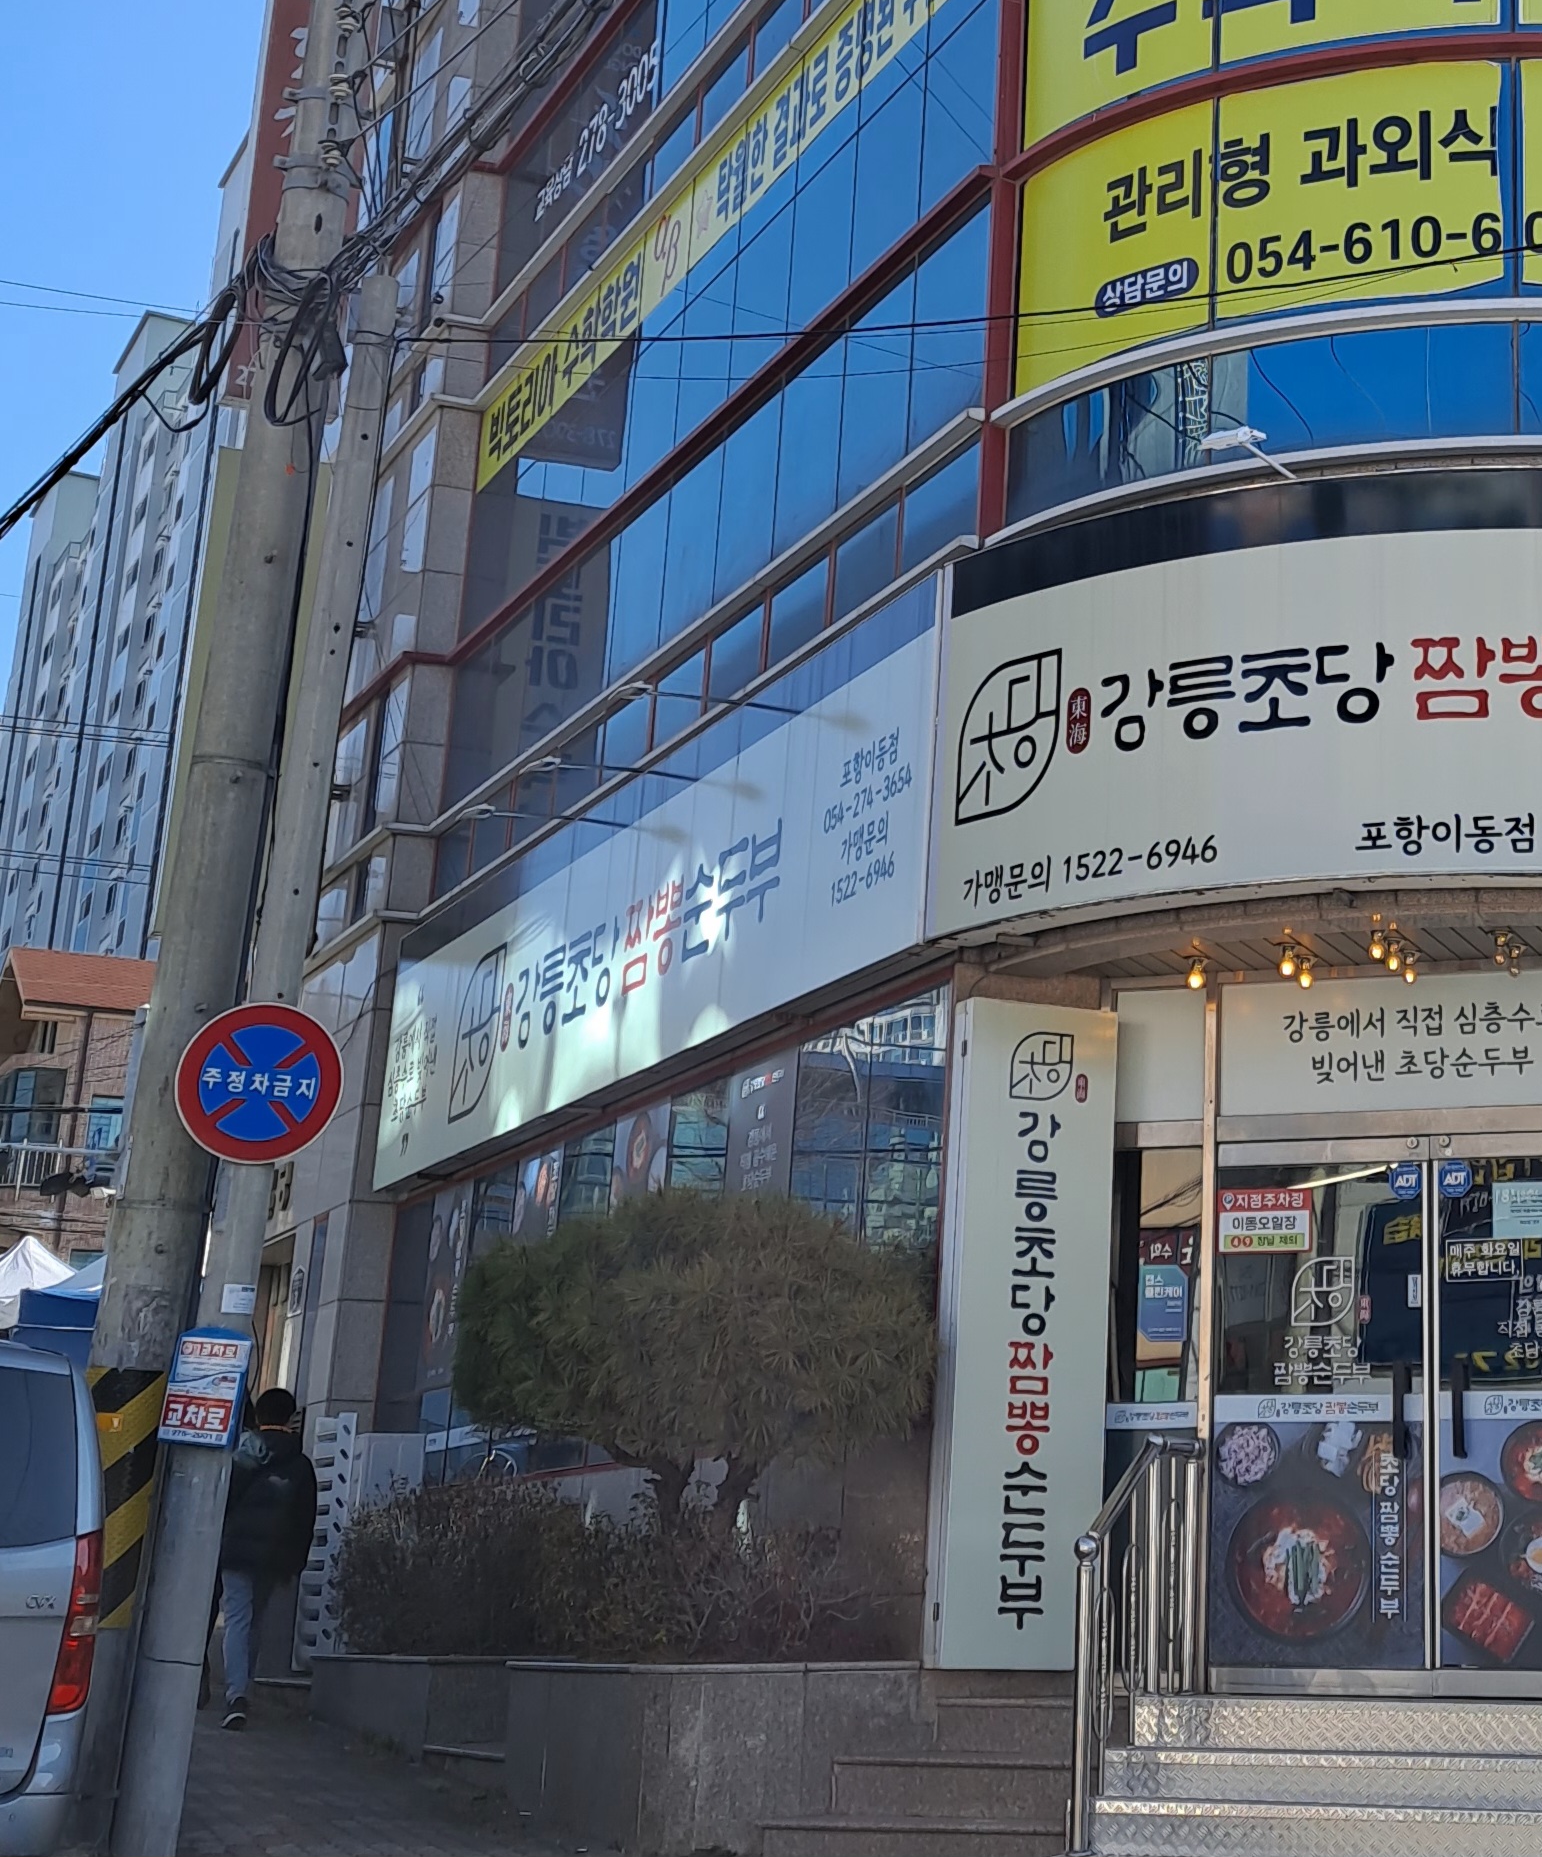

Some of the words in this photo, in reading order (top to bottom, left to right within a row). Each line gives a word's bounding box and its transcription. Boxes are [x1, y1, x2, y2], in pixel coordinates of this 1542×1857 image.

[576, 38, 661, 178] 278-3005
[1102, 131, 1272, 243] 관리형
[1300, 105, 1498, 189] 과외식
[1101, 258, 1191, 314] 상담문의
[823, 770, 913, 833] 054-274-3654
[841, 809, 889, 864] 가맹문의
[1355, 813, 1536, 857] 포항이동점
[830, 856, 895, 908] 1522-6946
[962, 854, 1052, 908] 가맹문의
[1062, 834, 1219, 884] 1522-6946
[1282, 1004, 1387, 1044] 강릉에서
[1396, 1005, 1445, 1039] 직접
[201, 1067, 317, 1100] 주정차금지
[1311, 1048, 1386, 1084] 빚어낸
[1395, 1045, 1535, 1080] 초당순두부
[1394, 1172, 1418, 1189] ADT
[1443, 1172, 1467, 1187] ADT
